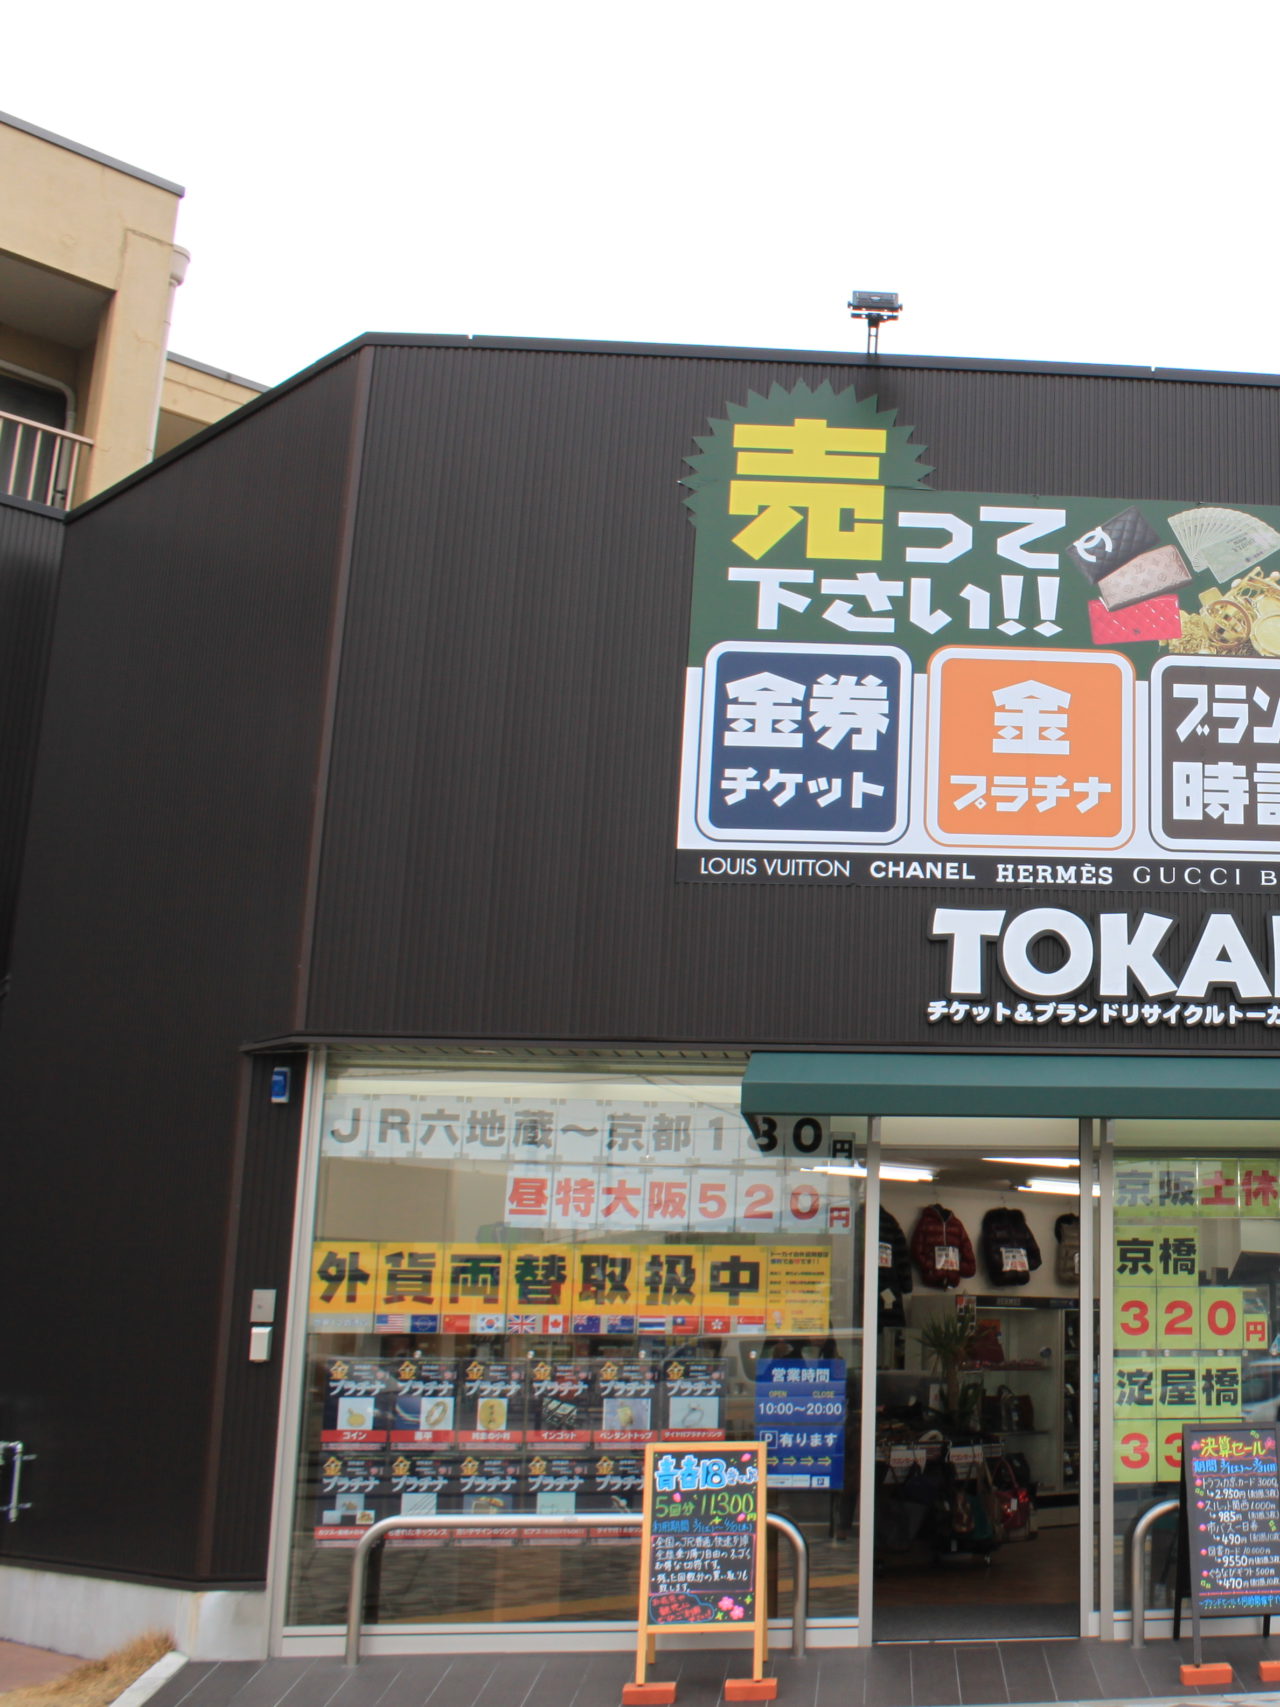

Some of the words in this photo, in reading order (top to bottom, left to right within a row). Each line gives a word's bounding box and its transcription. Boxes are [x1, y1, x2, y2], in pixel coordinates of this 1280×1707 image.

[724, 672, 890, 751] 金券
[991, 680, 1071, 756] 金
[720, 767, 885, 809] チケット
[950, 773, 1112, 813] プラチナ
[700, 857, 757, 876] LOUIS
[764, 859, 850, 877] VUITTON
[869, 861, 976, 880] CHANEL
[1132, 866, 1241, 886] GUCCI
[1117, 1238, 1197, 1275] 京橋
[317, 1251, 761, 1305] 外貨両替取扱中
[1120, 1300, 1266, 1342] 320円
[772, 1368, 830, 1383] 営業時間
[1117, 1368, 1240, 1406] 淀屋橋
[1201, 1436, 1266, 1457] 決算セール
